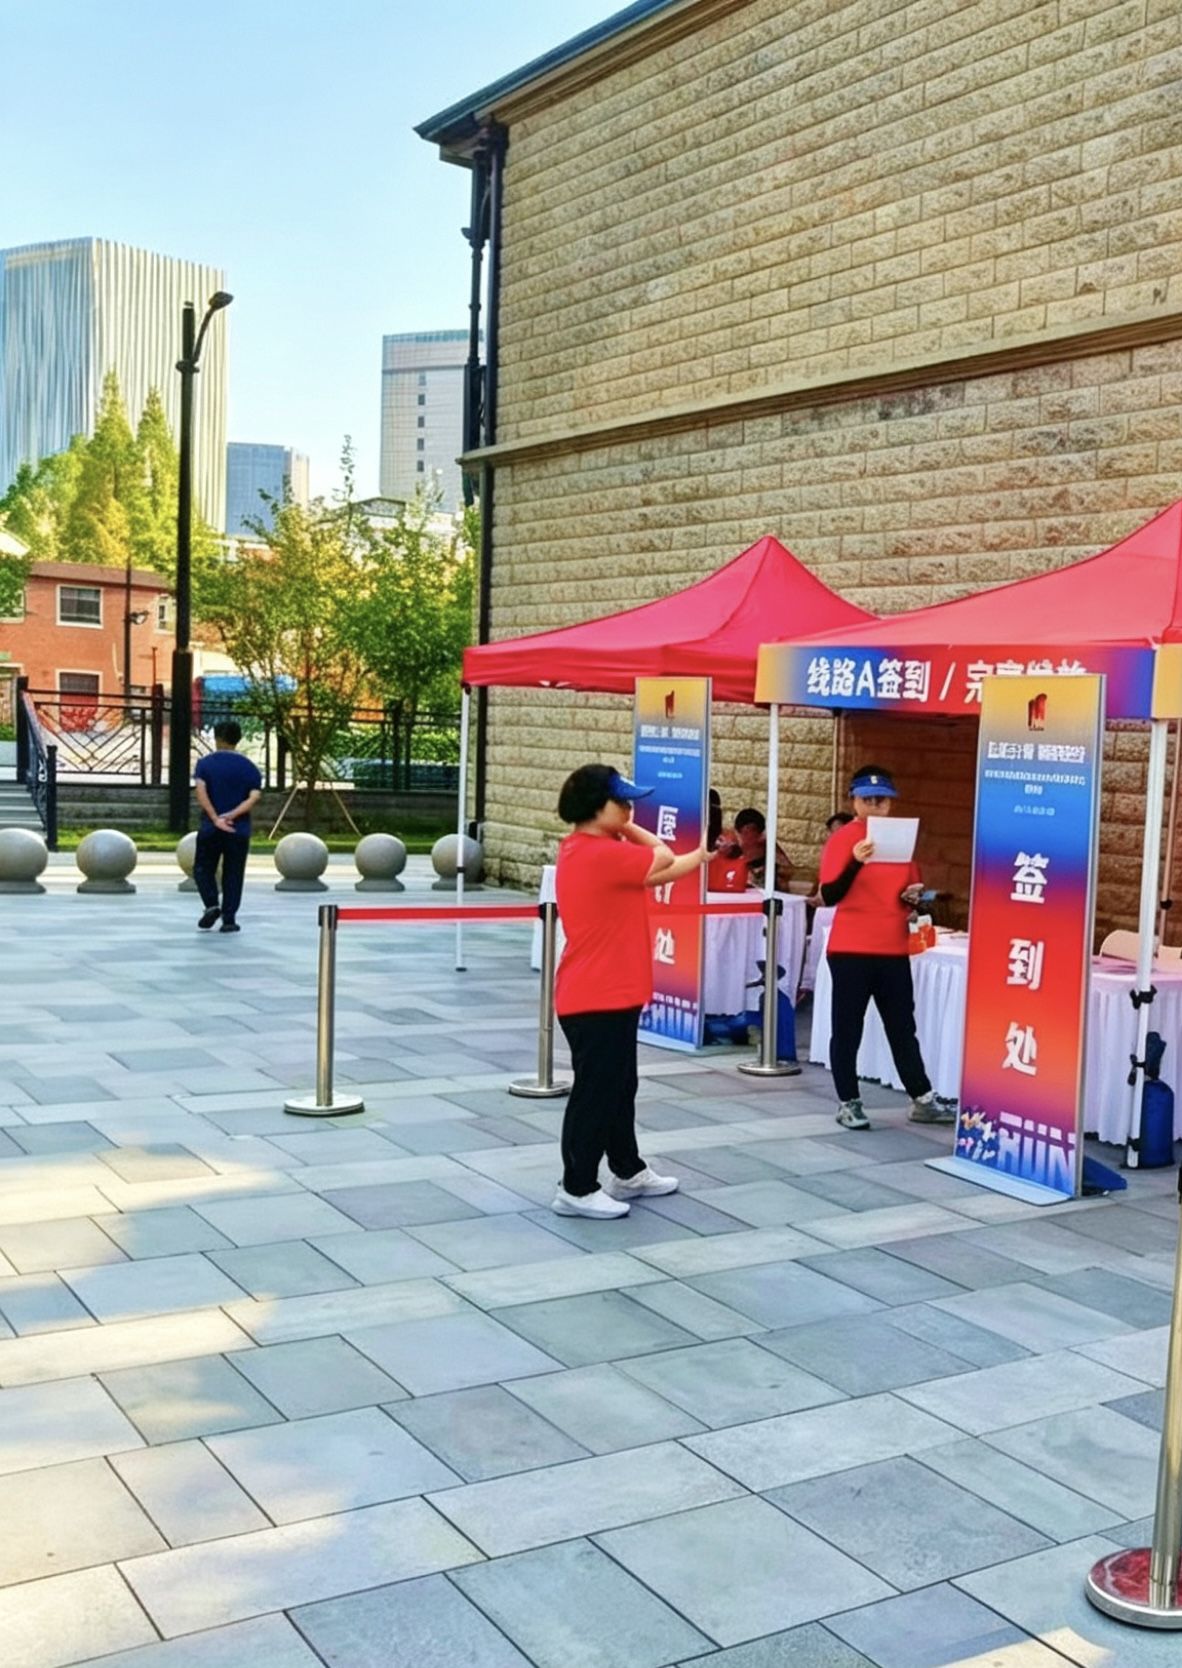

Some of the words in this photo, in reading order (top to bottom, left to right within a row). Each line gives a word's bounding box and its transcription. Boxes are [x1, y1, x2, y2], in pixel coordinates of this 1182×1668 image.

[807, 656, 931, 702] 线路A签到
[1002, 851, 1049, 1076] 签到处
